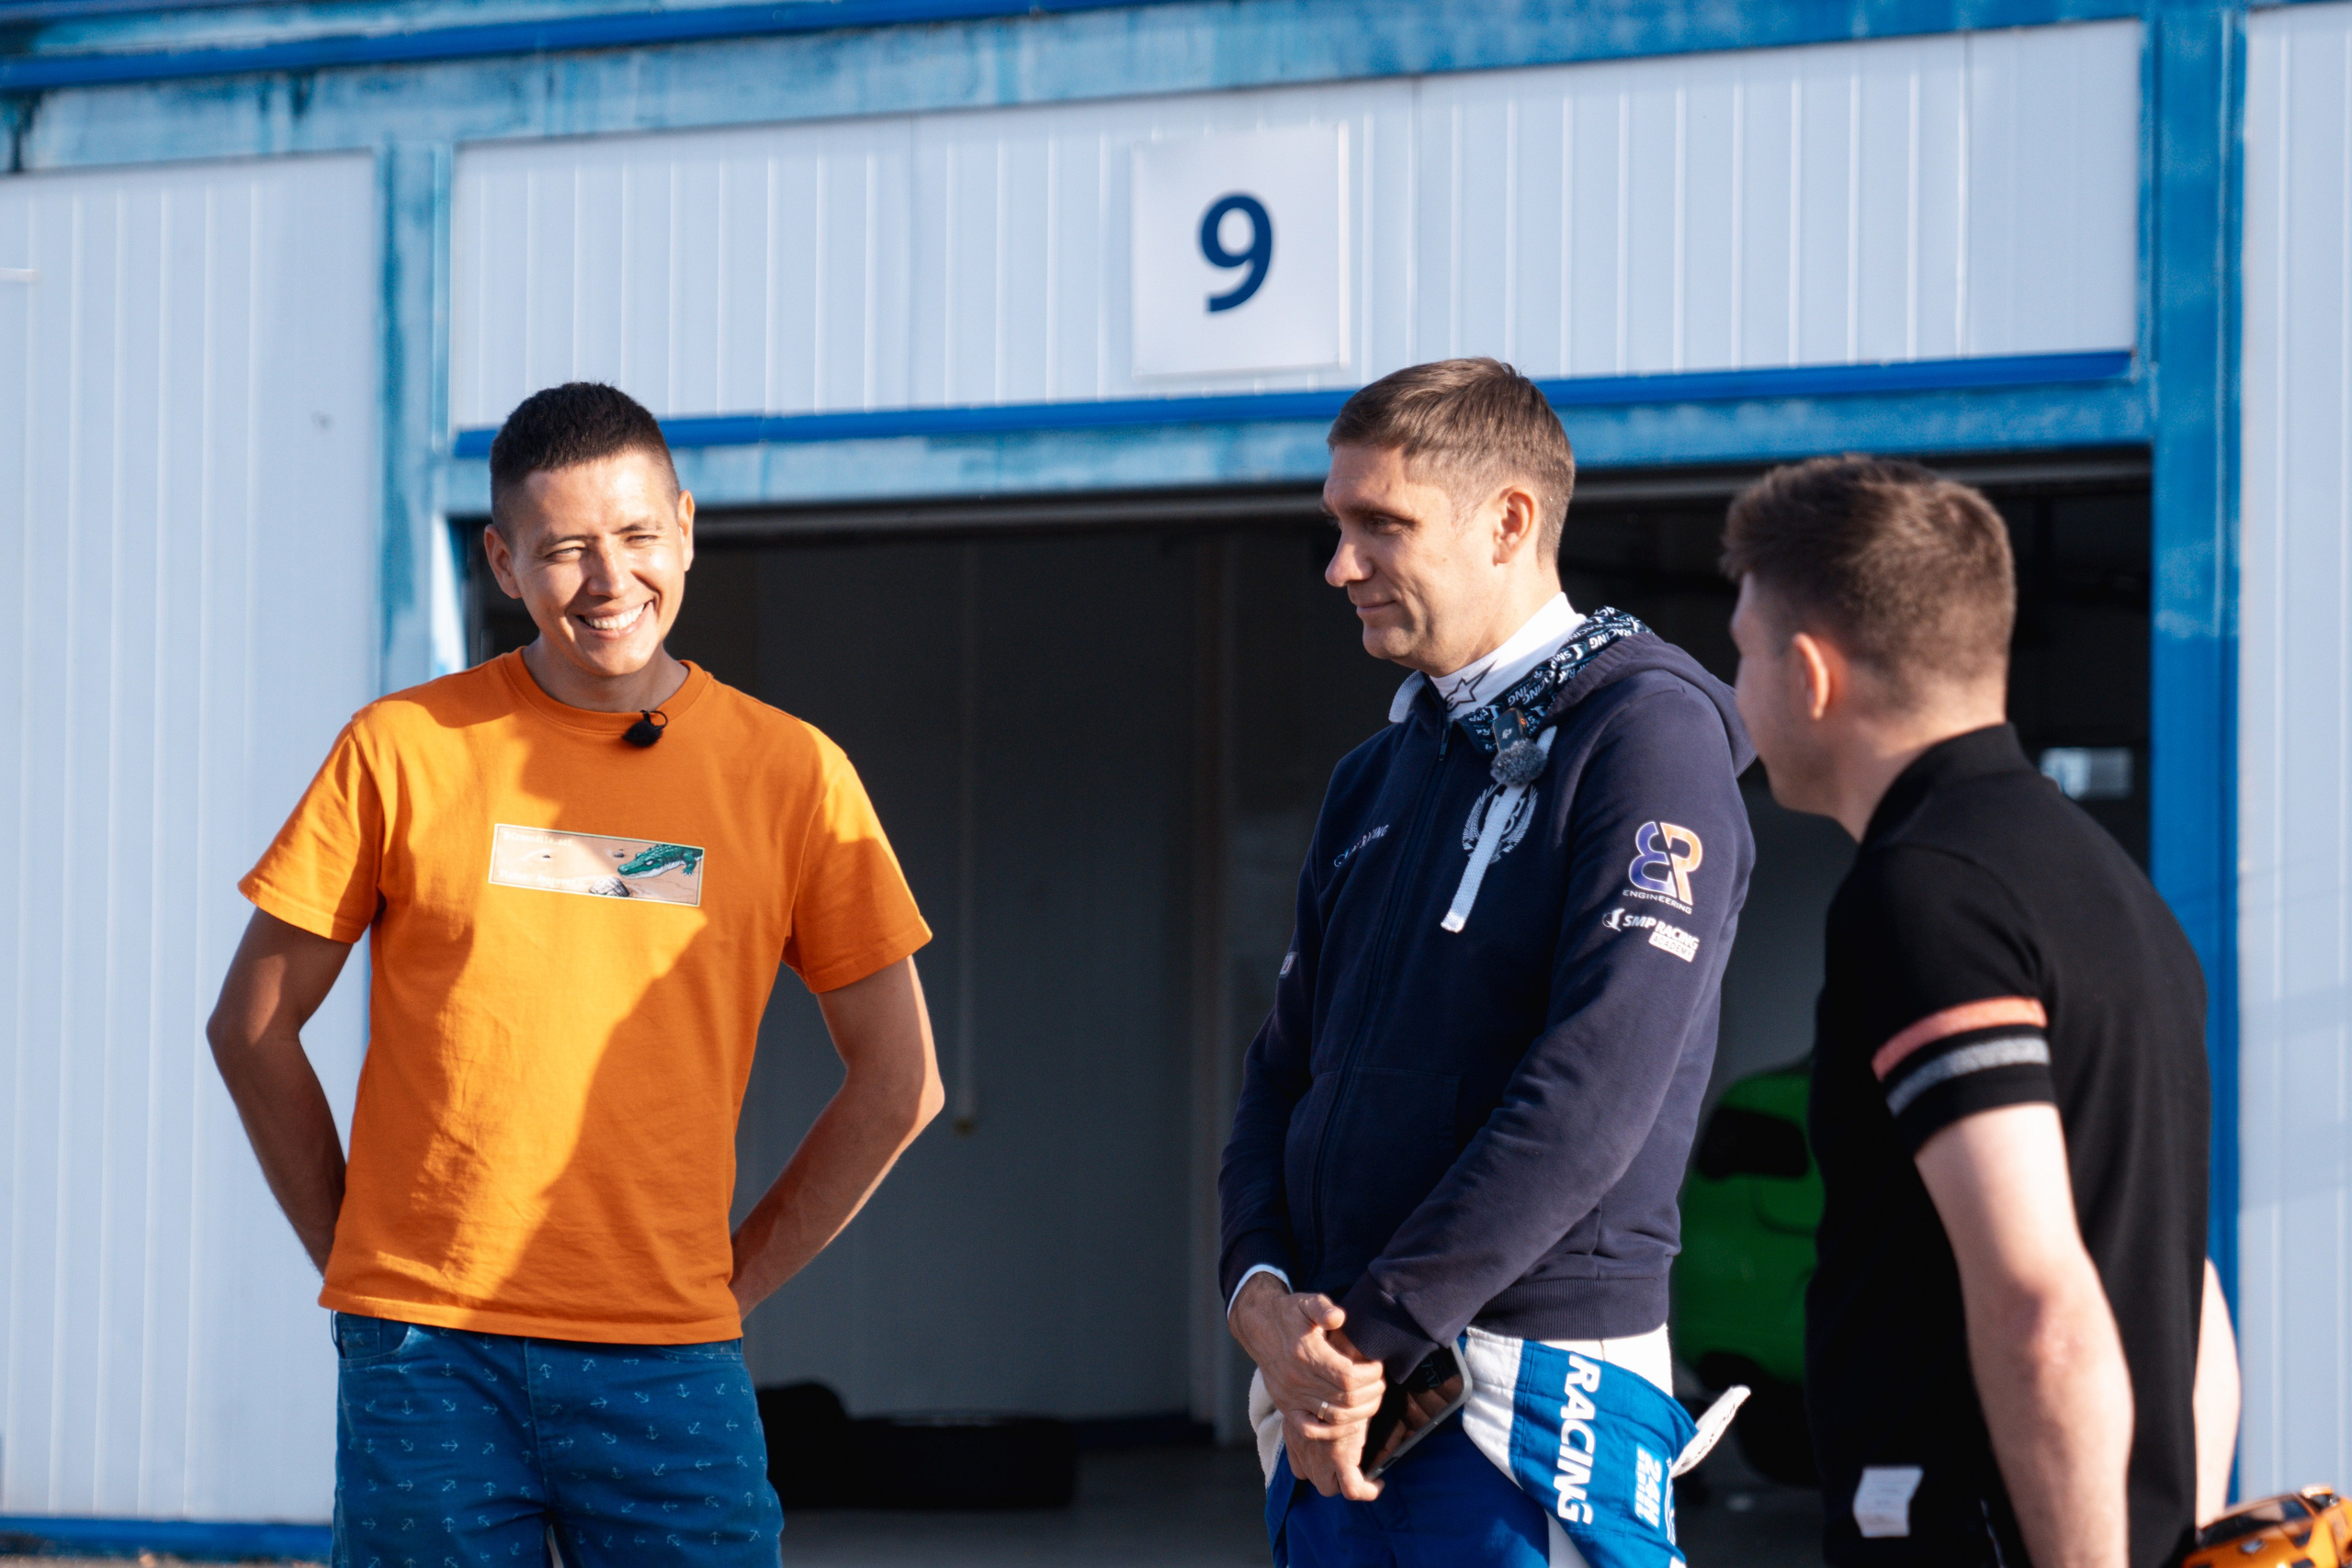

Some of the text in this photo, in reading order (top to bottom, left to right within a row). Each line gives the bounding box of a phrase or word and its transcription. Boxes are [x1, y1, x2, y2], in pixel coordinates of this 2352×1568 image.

[1199, 191, 1273, 314] 9
[1589, 628, 1632, 650] RACING
[1623, 889, 1692, 915] ENGINEERING
[1623, 915, 1700, 951] SMP RACING
[1653, 935, 1693, 959] ACADEMY
[1553, 1354, 1601, 1525] RACING
